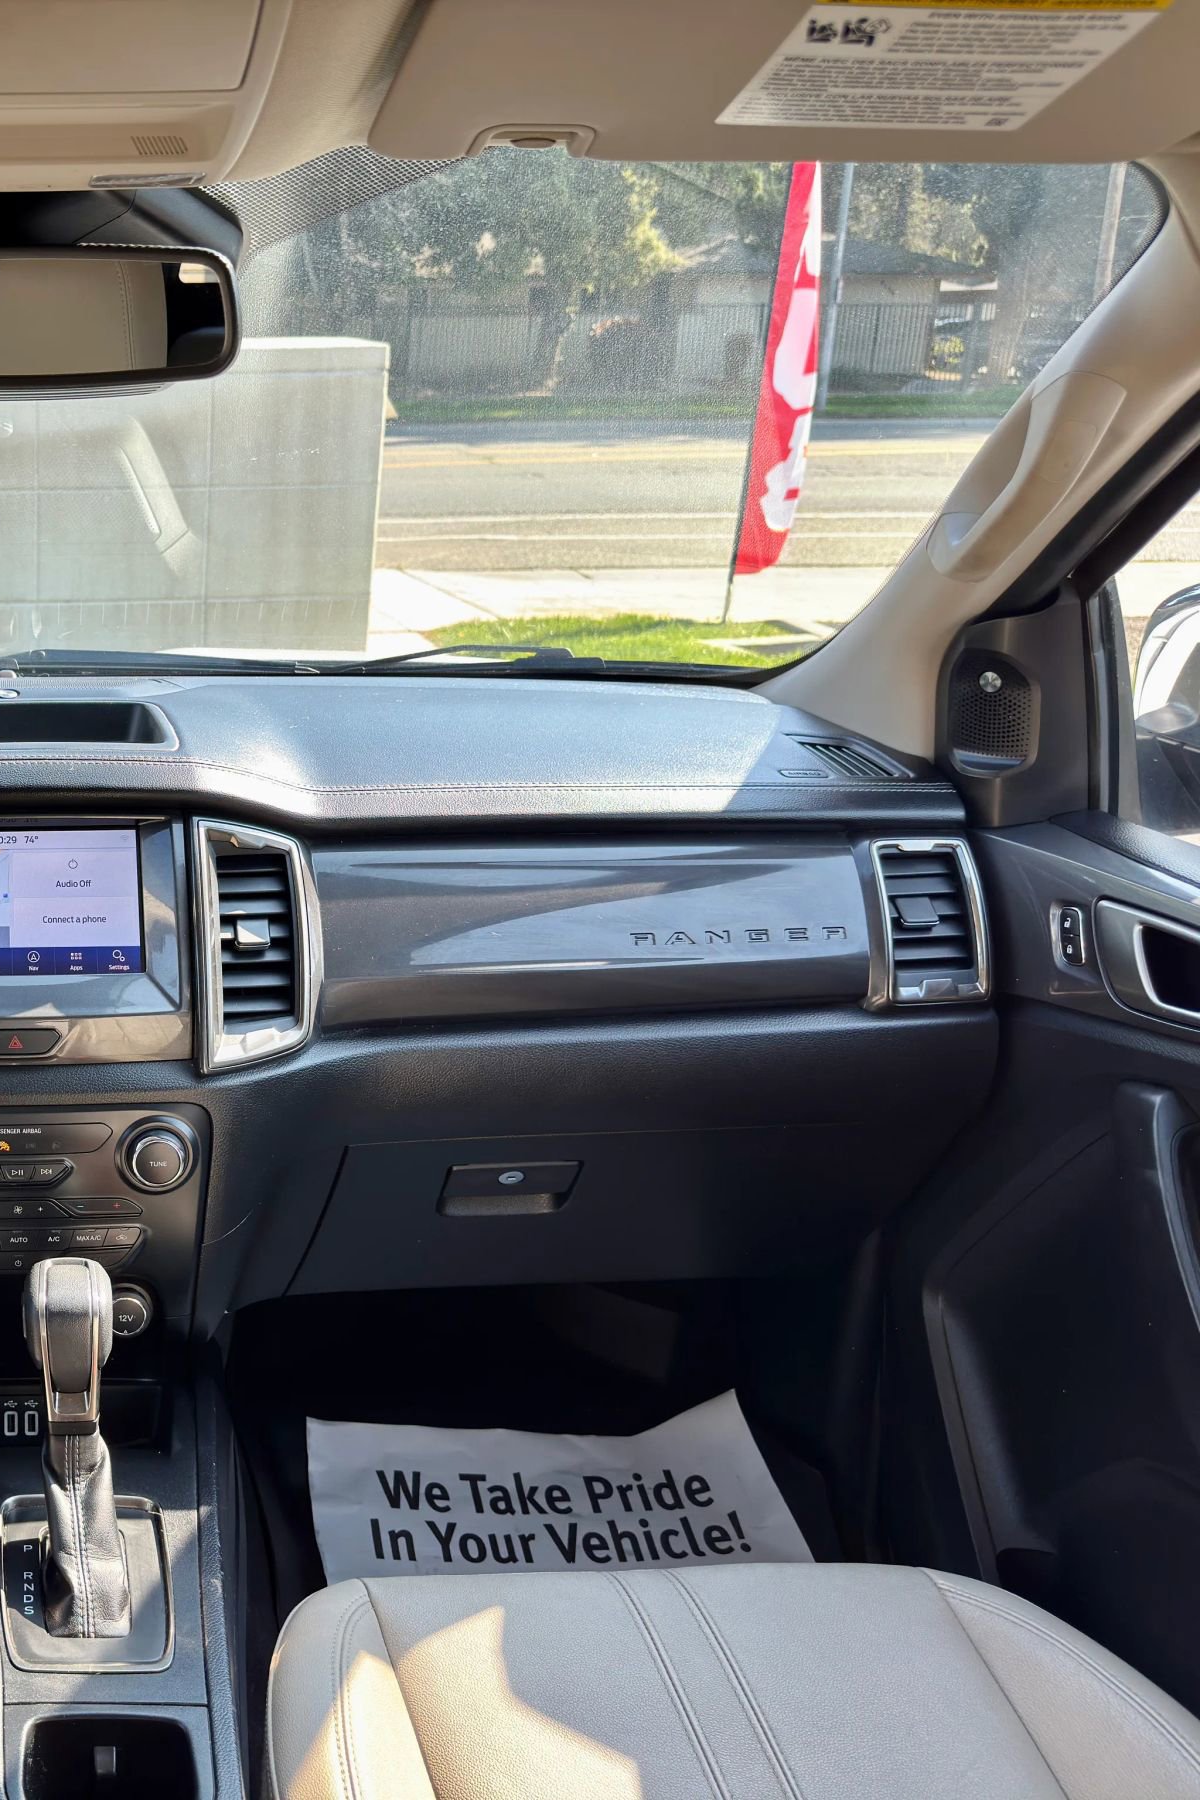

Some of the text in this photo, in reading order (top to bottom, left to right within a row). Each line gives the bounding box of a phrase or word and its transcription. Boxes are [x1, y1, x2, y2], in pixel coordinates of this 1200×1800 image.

[24, 835, 39, 844] 74°
[55, 880, 92, 888] Audio Off
[42, 915, 74, 924] Connect
[82, 915, 107, 925] phone
[629, 926, 848, 946] RANGER
[70, 964, 83, 972] Apps
[109, 964, 130, 972] Settings
[118, 1315, 134, 1323] 12V
[375, 1469, 715, 1516] We Take Pride
[370, 1510, 754, 1565] In Your Vehicle!
[23, 1545, 33, 1553] P
[23, 1571, 34, 1580] R
[23, 1583, 34, 1592] N
[23, 1595, 34, 1603] D
[24, 1606, 35, 1615] S
